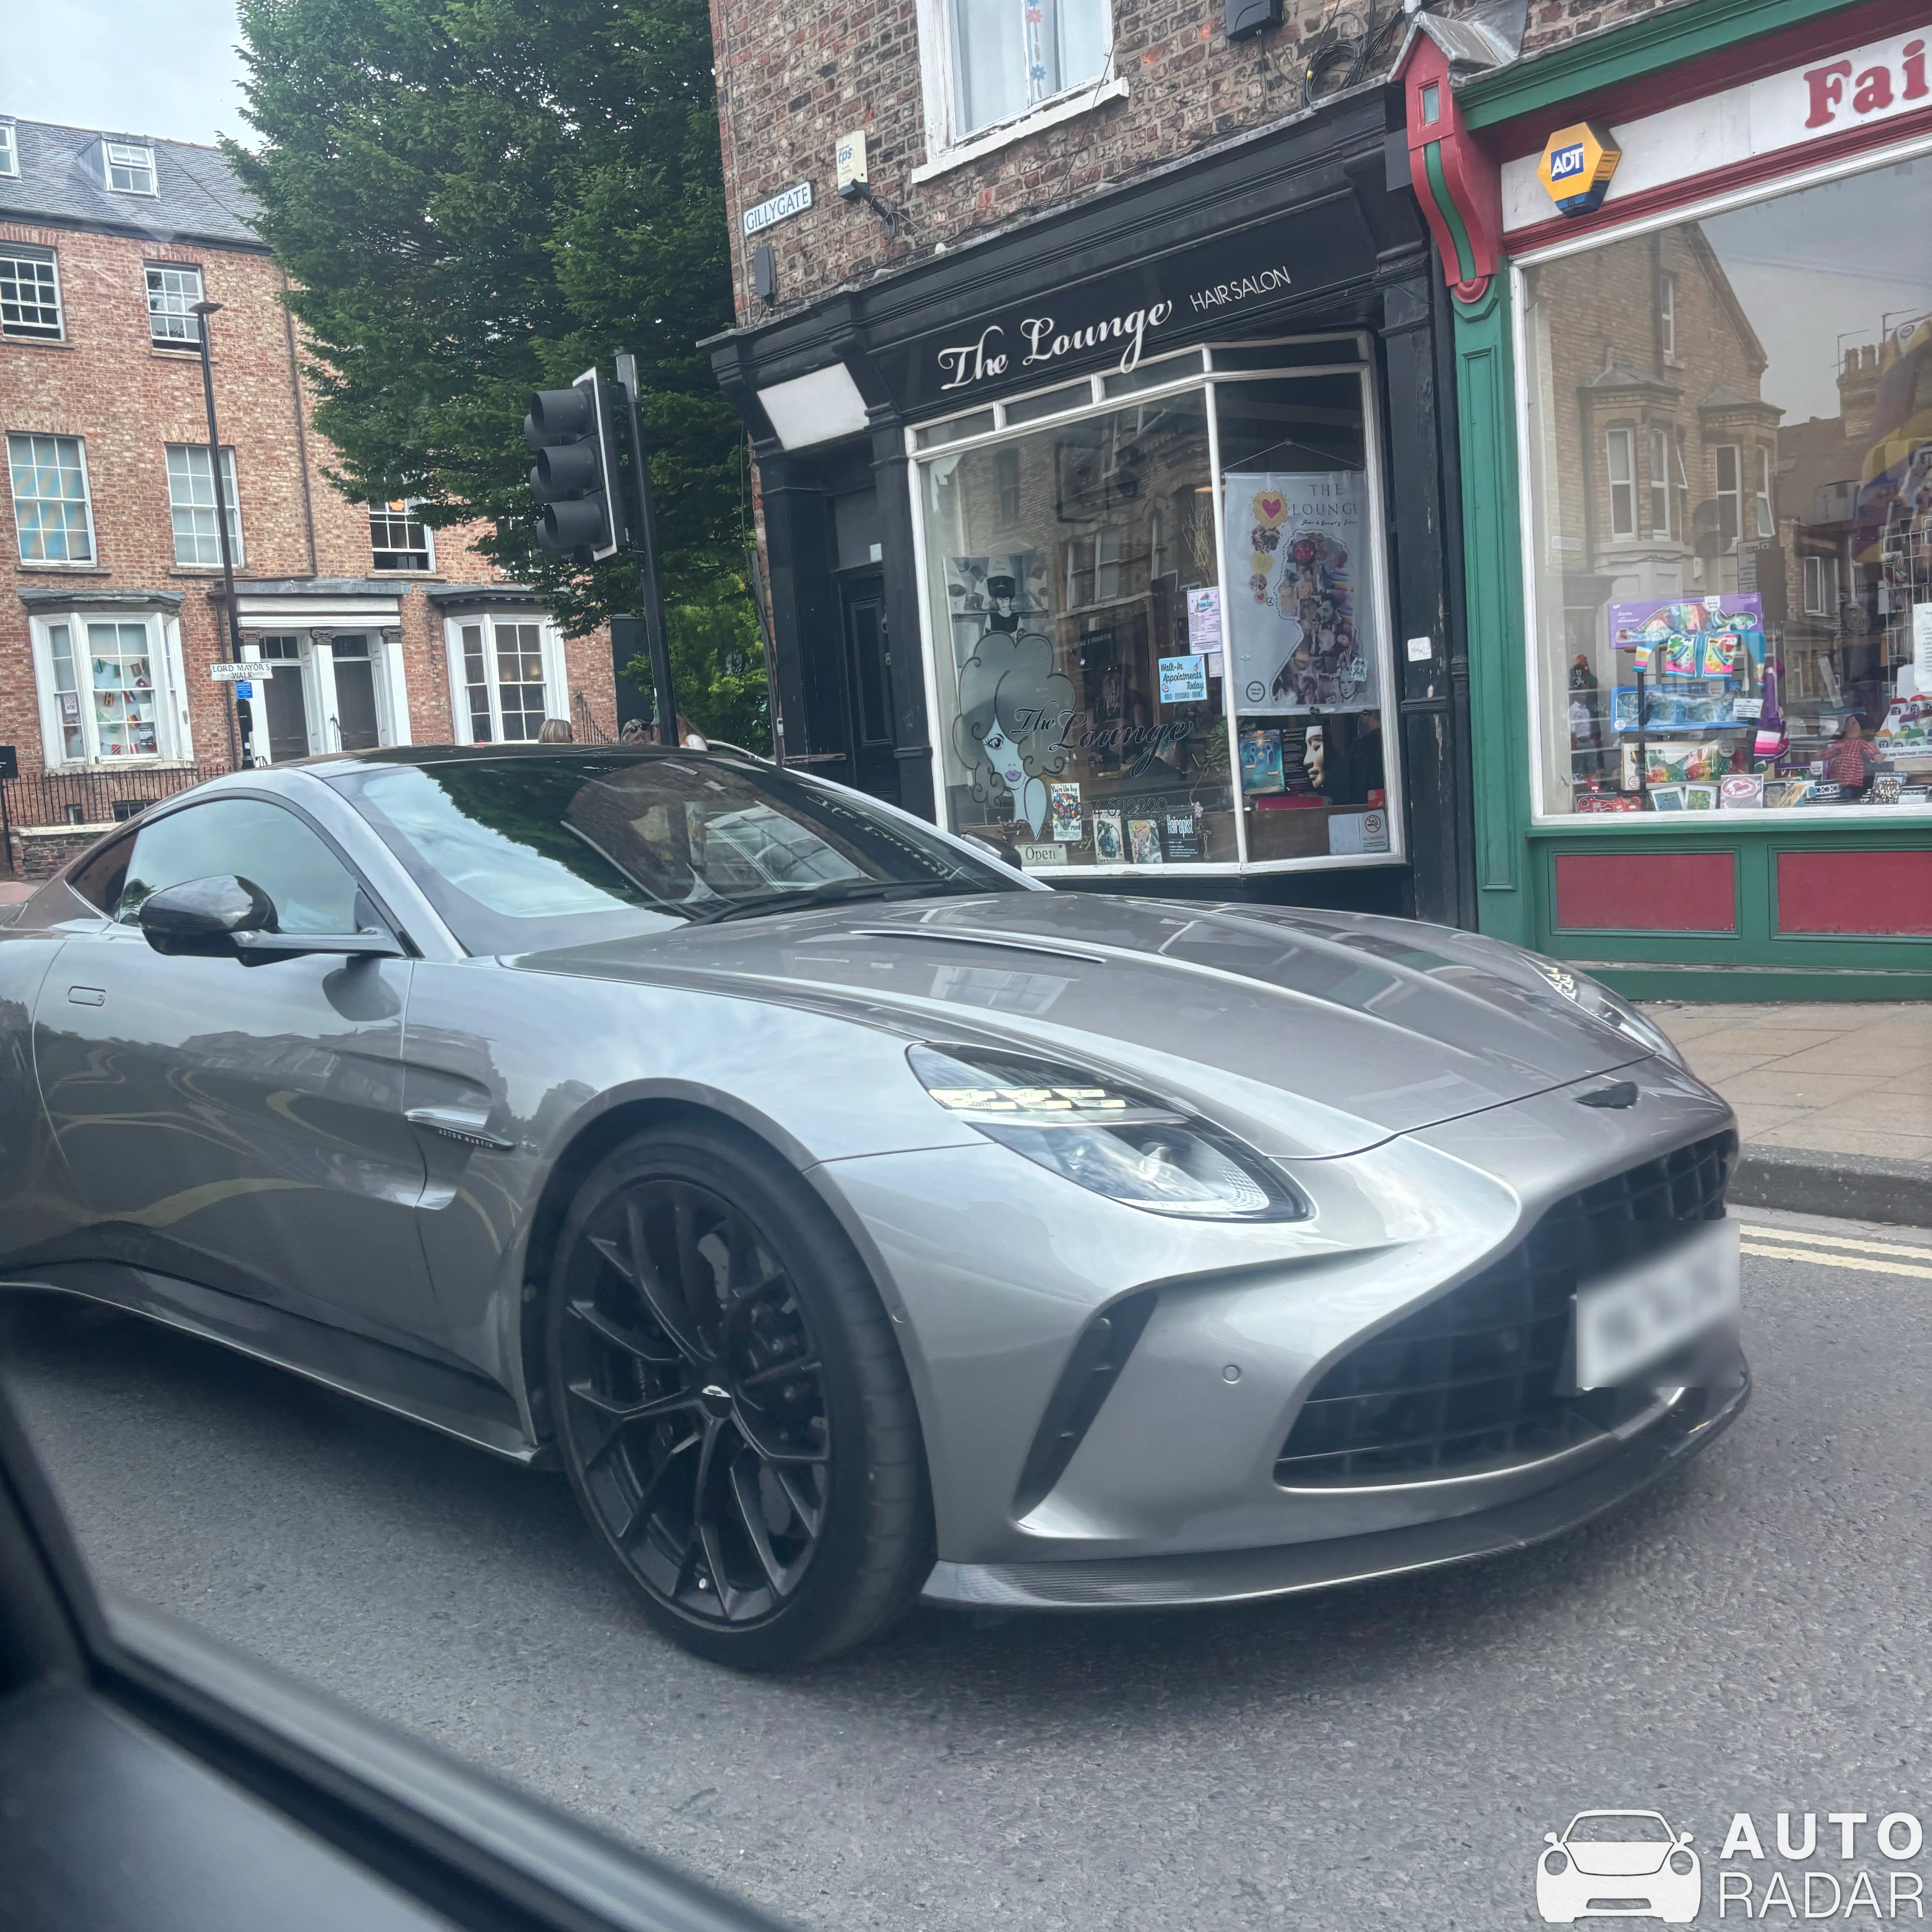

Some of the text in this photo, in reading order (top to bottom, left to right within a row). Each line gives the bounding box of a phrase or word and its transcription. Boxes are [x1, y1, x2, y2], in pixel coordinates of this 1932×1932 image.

[1803, 39, 1929, 129] Fai
[1551, 147, 1583, 177] ADT
[746, 186, 809, 230] GILLYGATE
[938, 325, 1009, 390] The
[1020, 299, 1173, 373] Lounge
[1308, 483, 1343, 496] THE
[212, 664, 234, 672] LORD
[1163, 671, 1203, 684] Appointments
[1187, 681, 1204, 691] Today
[1010, 699, 1192, 778] The Lounge
[1026, 846, 1056, 861] Open
